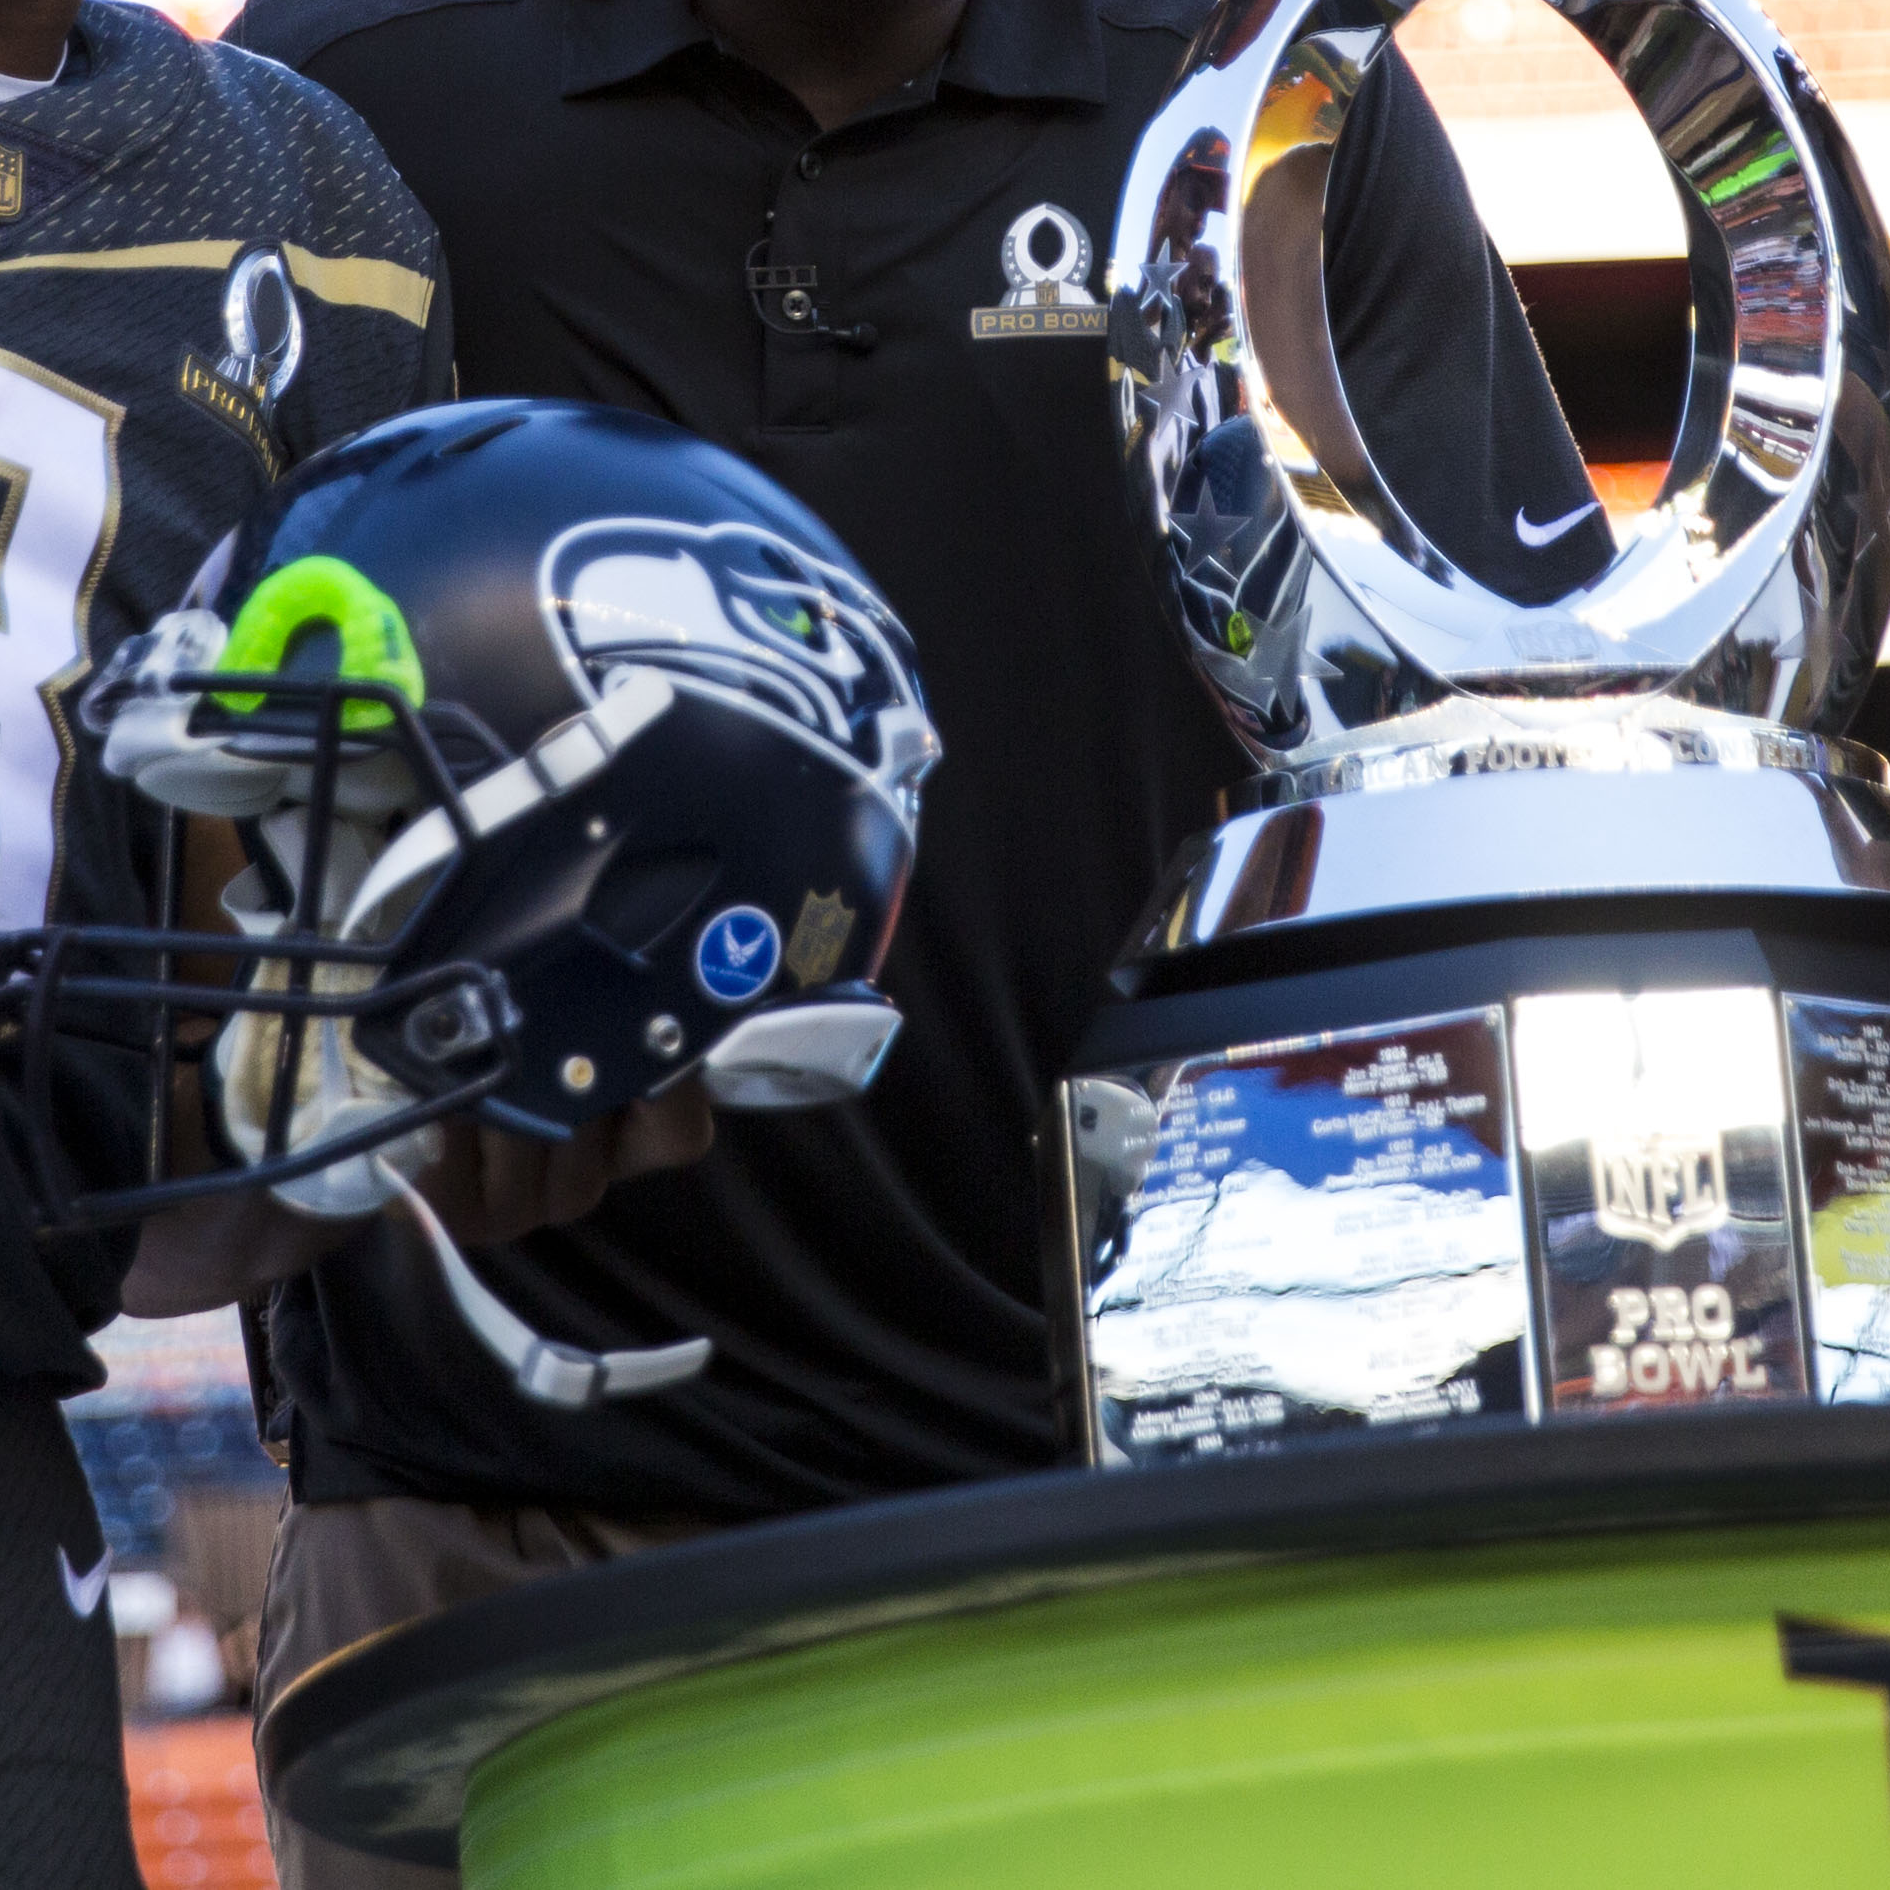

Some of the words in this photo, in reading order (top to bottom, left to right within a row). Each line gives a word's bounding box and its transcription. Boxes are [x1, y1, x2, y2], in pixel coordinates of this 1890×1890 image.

[981, 313, 1036, 331] PRO
[192, 368, 245, 420] PRO
[1609, 1151, 1715, 1226] NFL
[1608, 1282, 1734, 1345] PRO
[1589, 1339, 1767, 1398] BOWL
